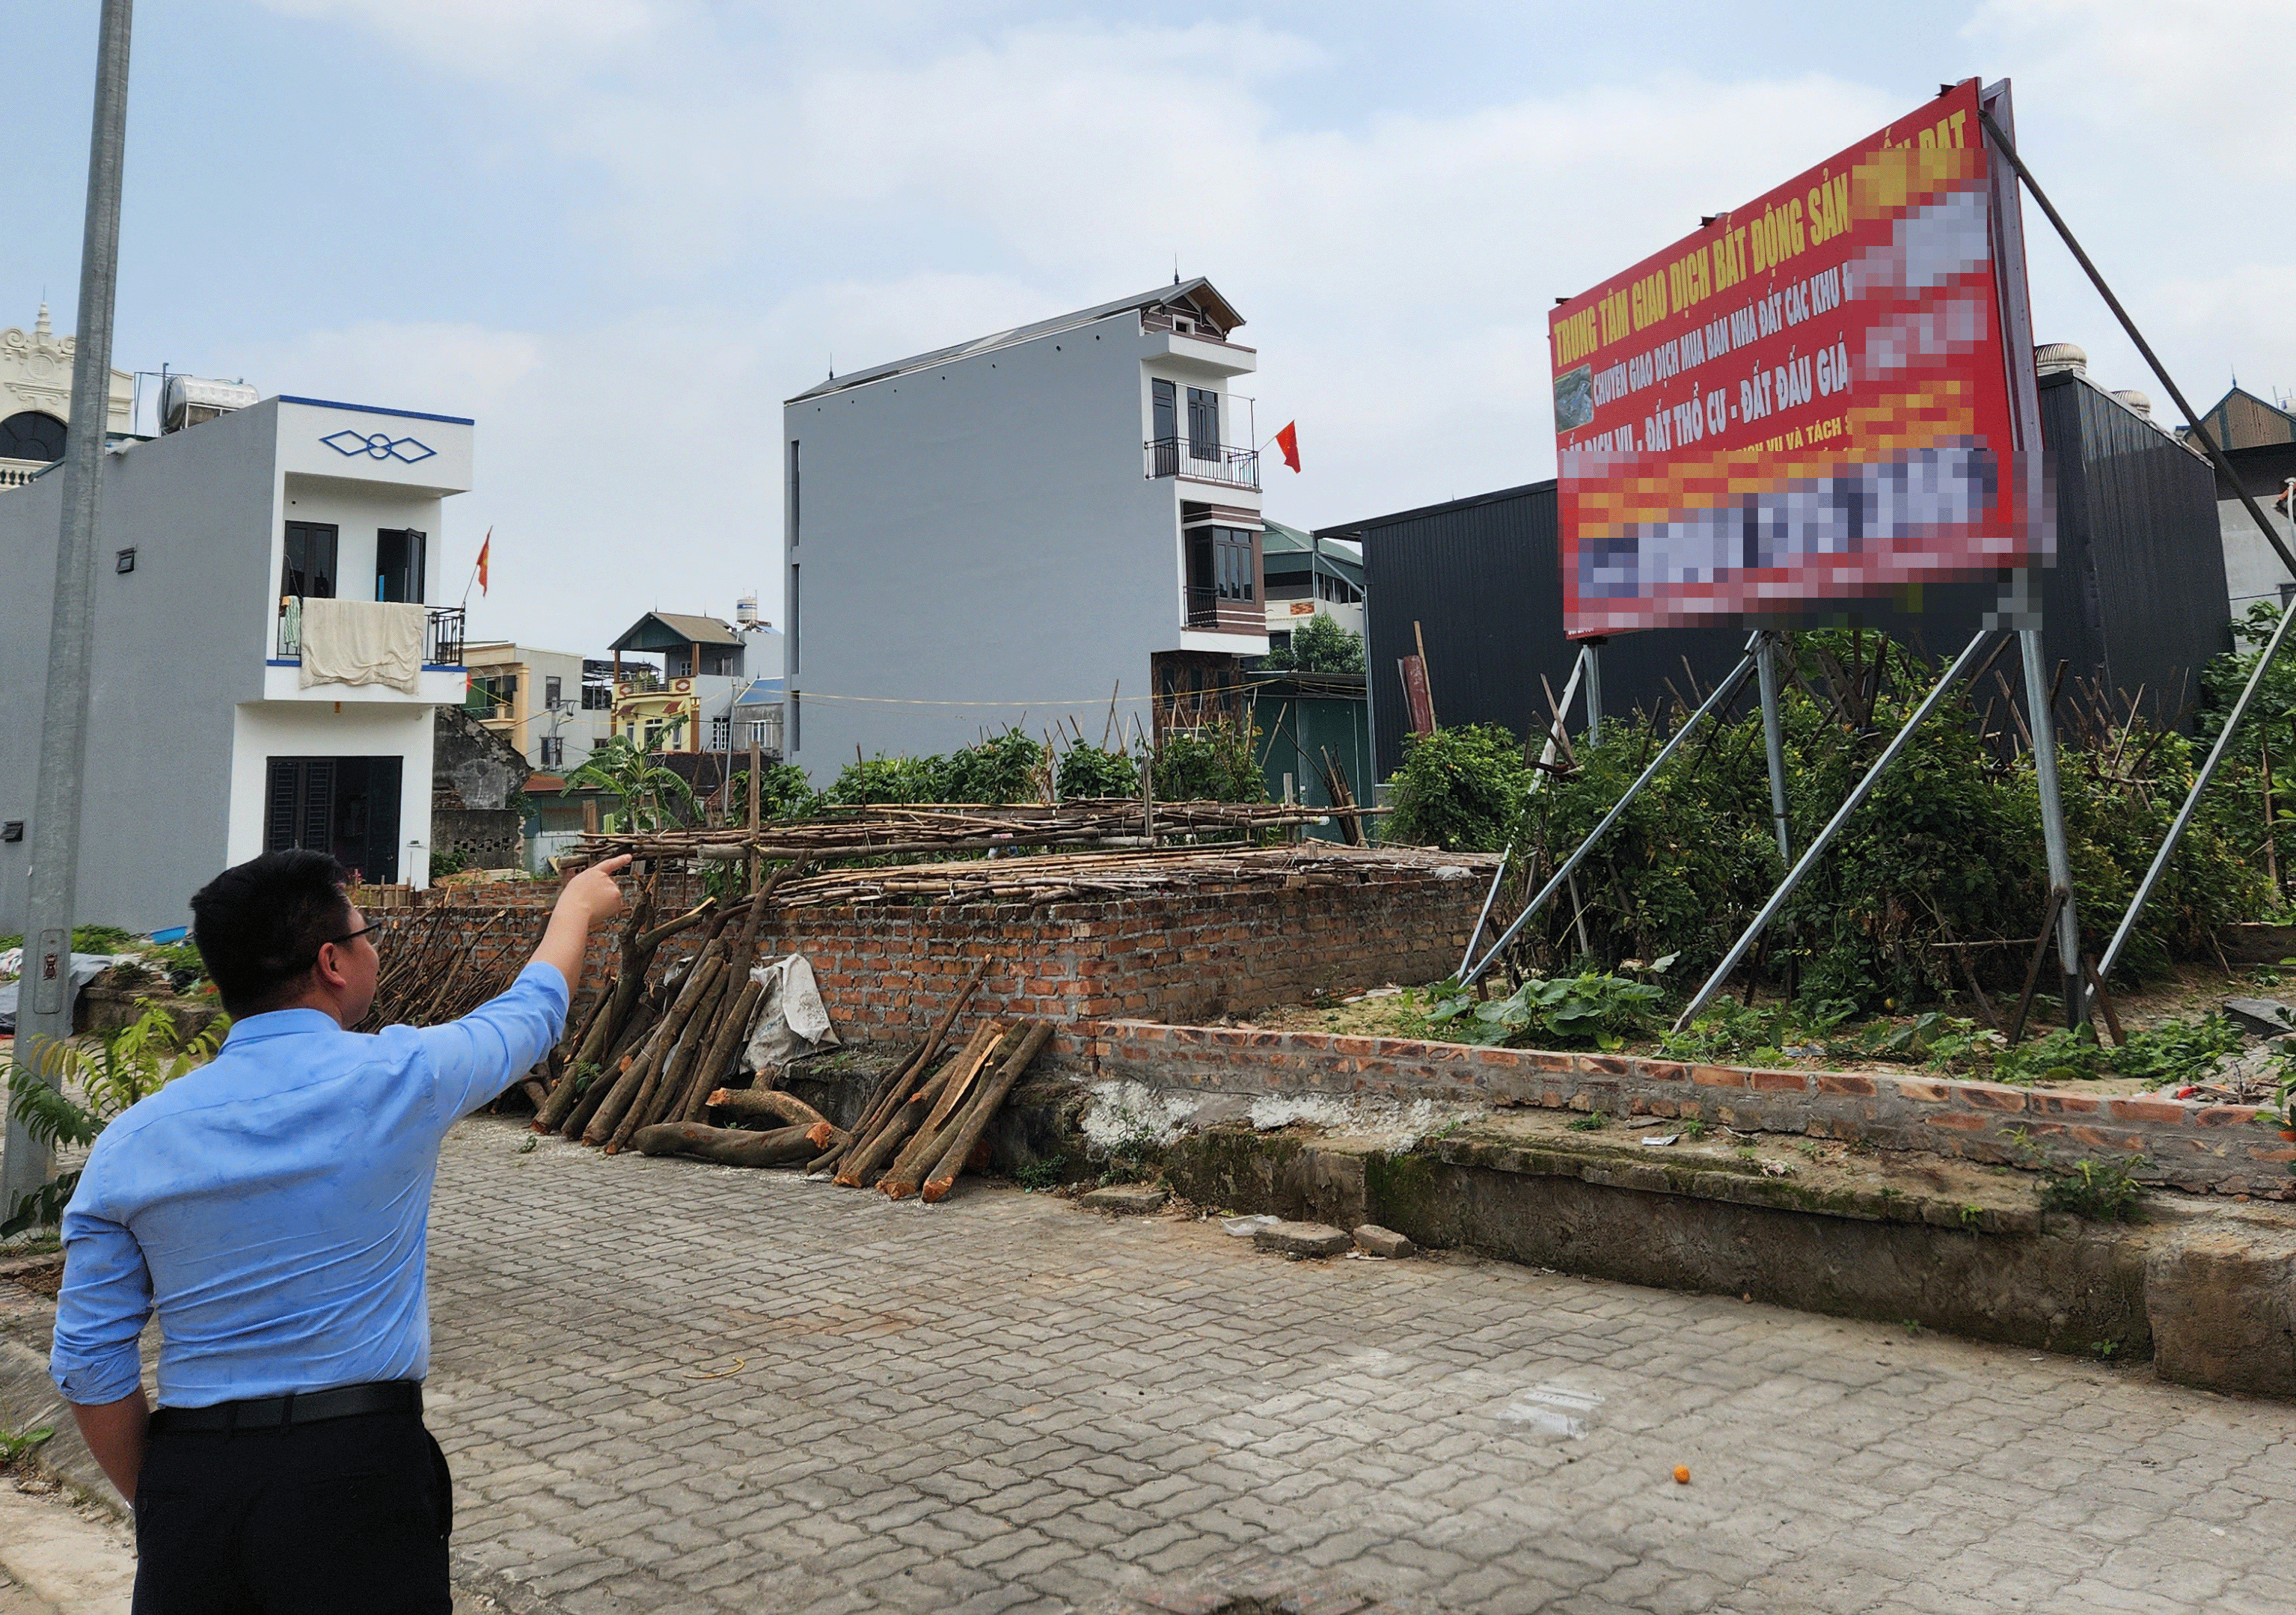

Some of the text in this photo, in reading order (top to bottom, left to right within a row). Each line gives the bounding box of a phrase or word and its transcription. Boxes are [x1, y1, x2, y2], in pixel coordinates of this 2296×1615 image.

[1554, 306, 1597, 367] TRUNG
[1599, 288, 1630, 347] TÂM
[1632, 269, 1668, 331] GIAO
[1669, 245, 1711, 318] DỊCH
[1712, 215, 1747, 292] BẤT
[1750, 197, 1805, 278] ĐỘNG
[1807, 167, 1848, 246] SẢN
[1629, 352, 1653, 393] GIAO
[1654, 339, 1679, 387] DỊCH
[1680, 328, 1706, 371] MUA
[1705, 312, 1730, 361] BÁN
[1730, 296, 1758, 350] NHÀ
[1758, 282, 1783, 338] ĐẤT
[1785, 276, 1810, 327] CÁC
[1810, 266, 1840, 316] KHU
[1673, 381, 1703, 446] THỔ
[1740, 358, 1772, 423] ĐẤT
[1775, 345, 1812, 411] ĐẤU
[1816, 331, 1848, 396] GIÁ
[1786, 426, 1804, 450] VÀ
[1805, 419, 1842, 444] TÁCH
